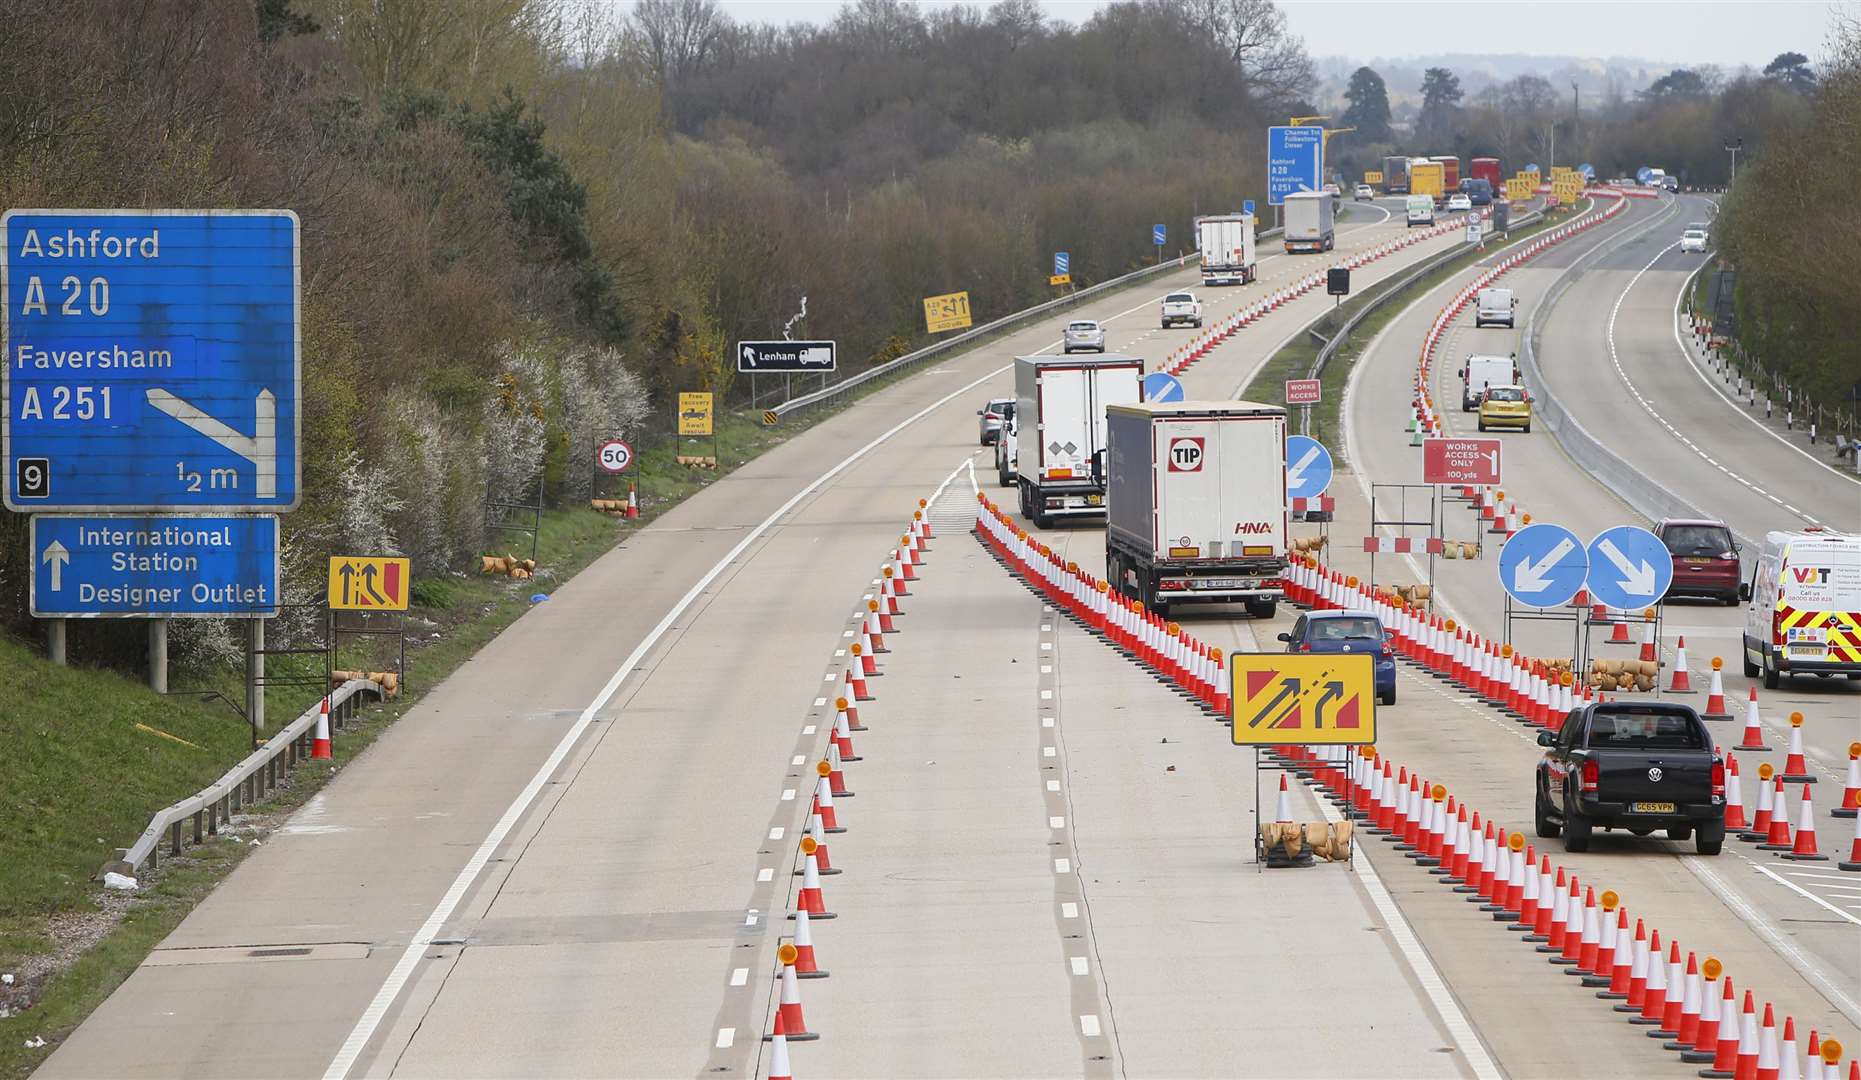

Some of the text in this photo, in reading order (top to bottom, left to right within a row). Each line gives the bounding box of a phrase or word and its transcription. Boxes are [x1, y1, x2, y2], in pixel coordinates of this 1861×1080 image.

[20, 229, 160, 258] Ashford
[17, 345, 172, 369] Faversham
[759, 352, 796, 361] Lenham
[604, 450, 627, 463] 50
[1173, 448, 1200, 463] TIP
[1444, 451, 1480, 459] ACCESS
[25, 466, 42, 489] 9
[211, 467, 238, 489] m
[1447, 471, 1477, 480] 100 yds
[80, 526, 231, 546] International
[1235, 523, 1272, 534] HNA
[111, 552, 197, 571] Station
[1792, 568, 1831, 583] VJT
[80, 584, 266, 606] Designer Outlet
